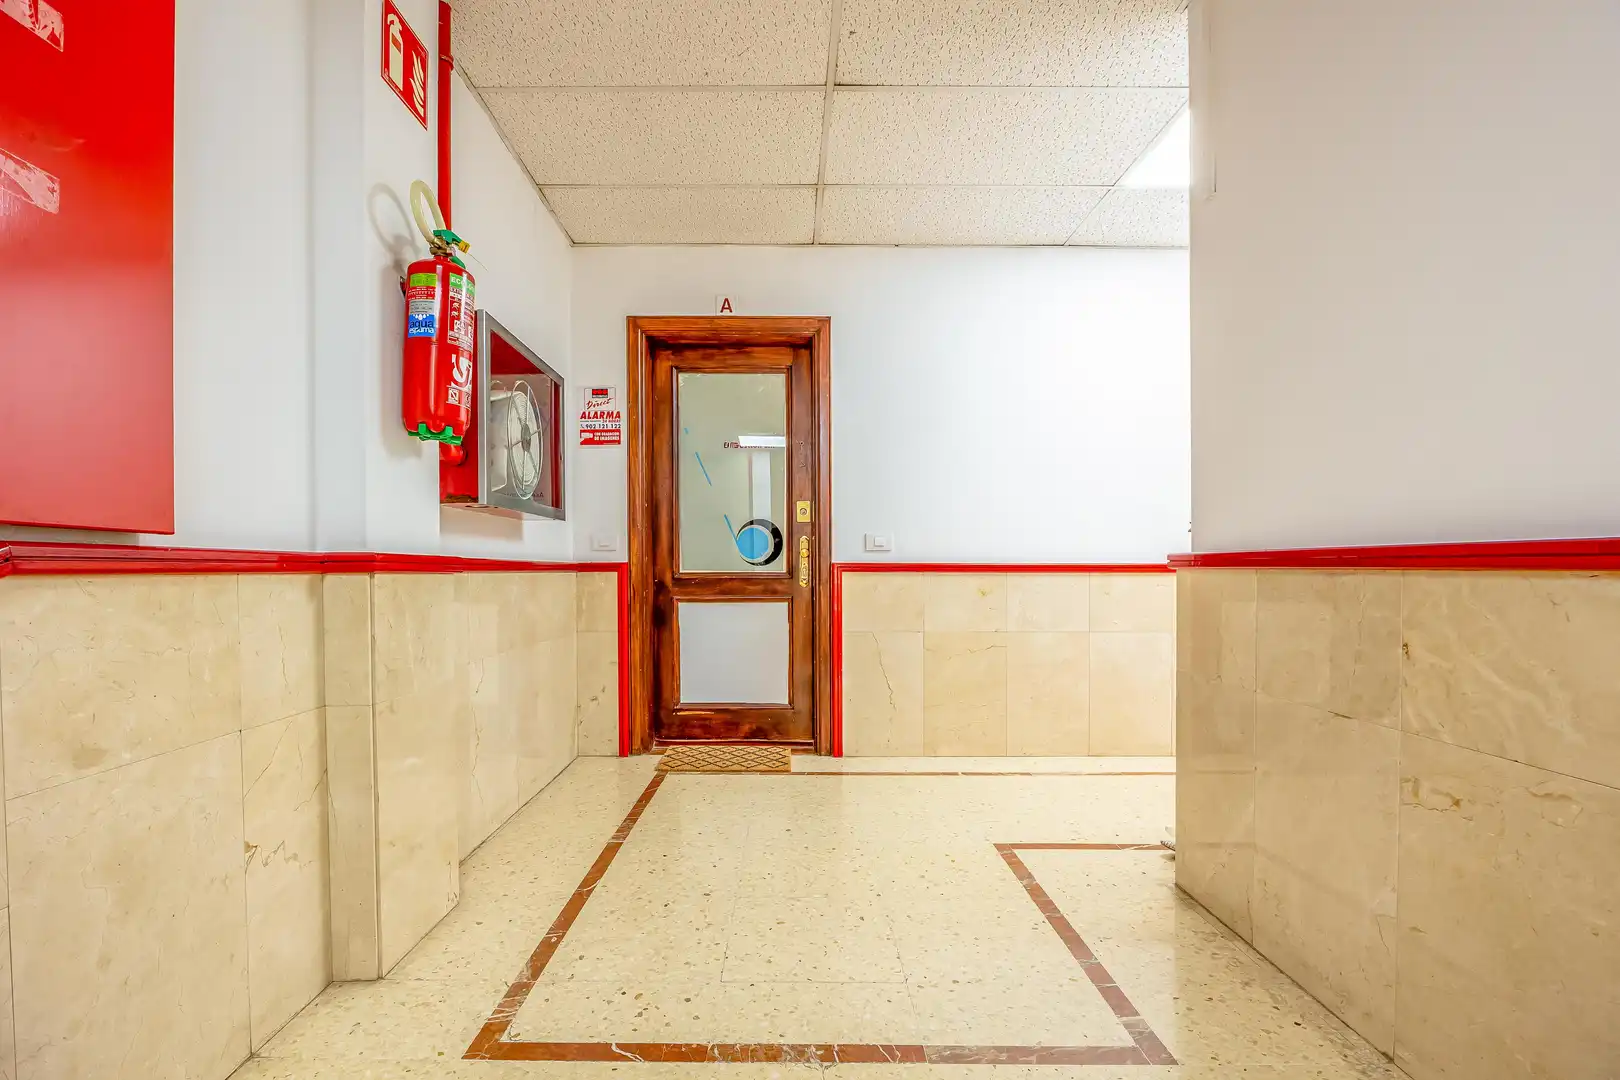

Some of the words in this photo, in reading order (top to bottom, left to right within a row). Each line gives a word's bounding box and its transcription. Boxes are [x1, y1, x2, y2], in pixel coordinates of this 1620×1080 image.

[720, 297, 733, 313] A
[409, 320, 434, 329] aqua
[586, 398, 614, 410] Direct
[580, 411, 621, 419] ALARMA
